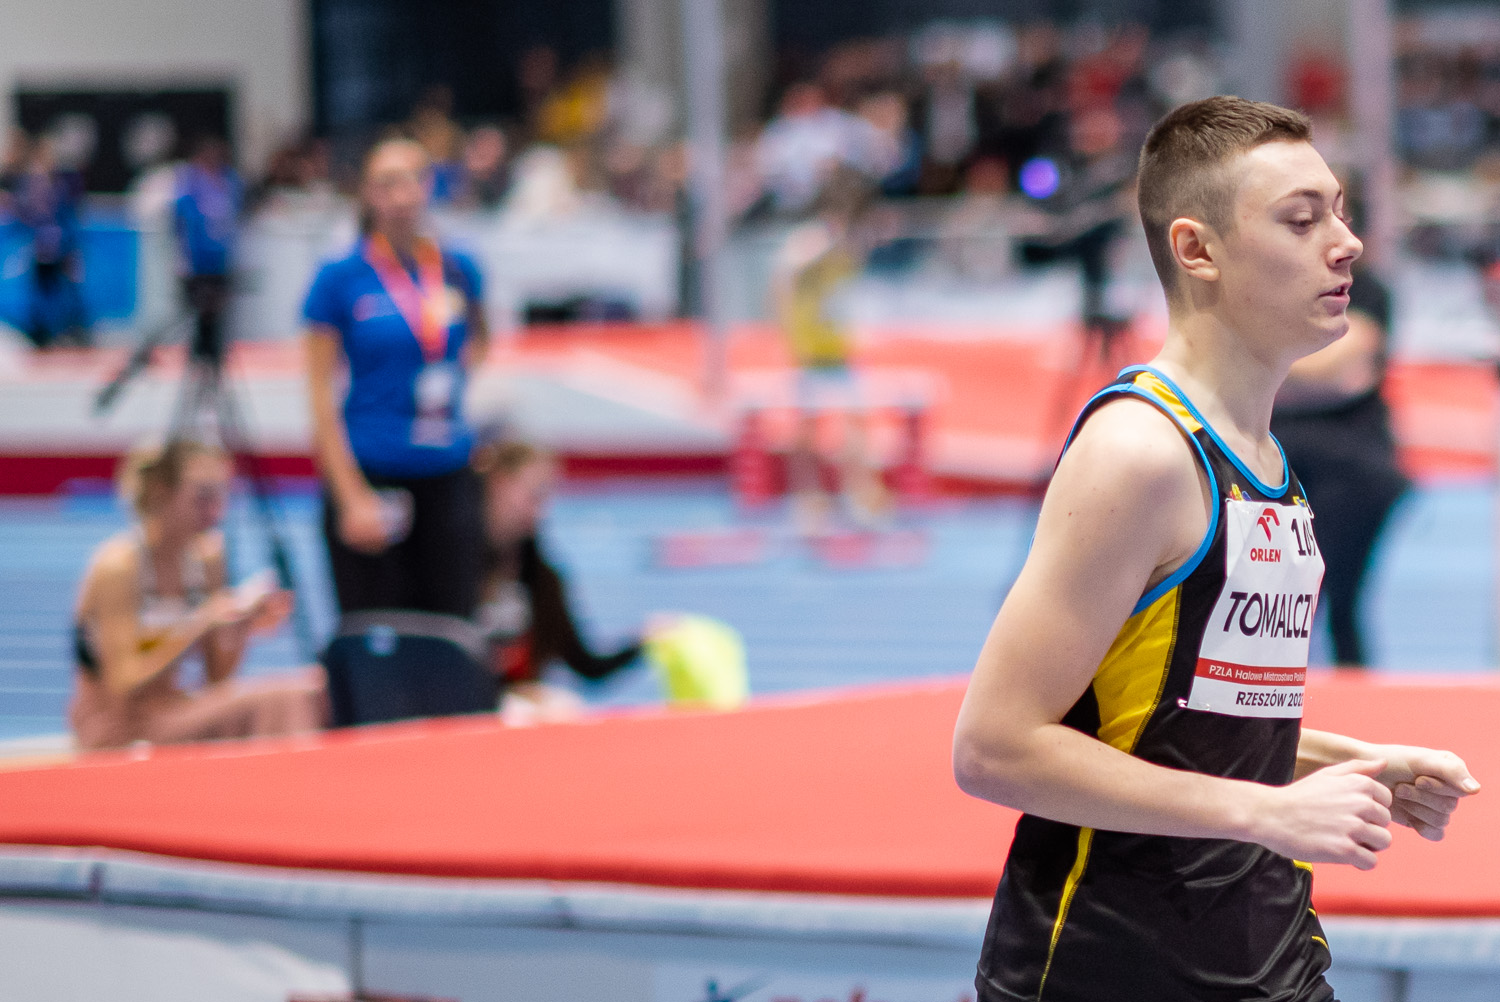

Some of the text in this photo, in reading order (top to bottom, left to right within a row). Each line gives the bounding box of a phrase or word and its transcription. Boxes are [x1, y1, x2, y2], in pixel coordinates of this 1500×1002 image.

[1250, 547, 1281, 563] ORLEN
[1208, 664, 1233, 678] PZLA
[1234, 669, 1263, 682] Halowe
[1235, 688, 1288, 707] RZESZÓW
